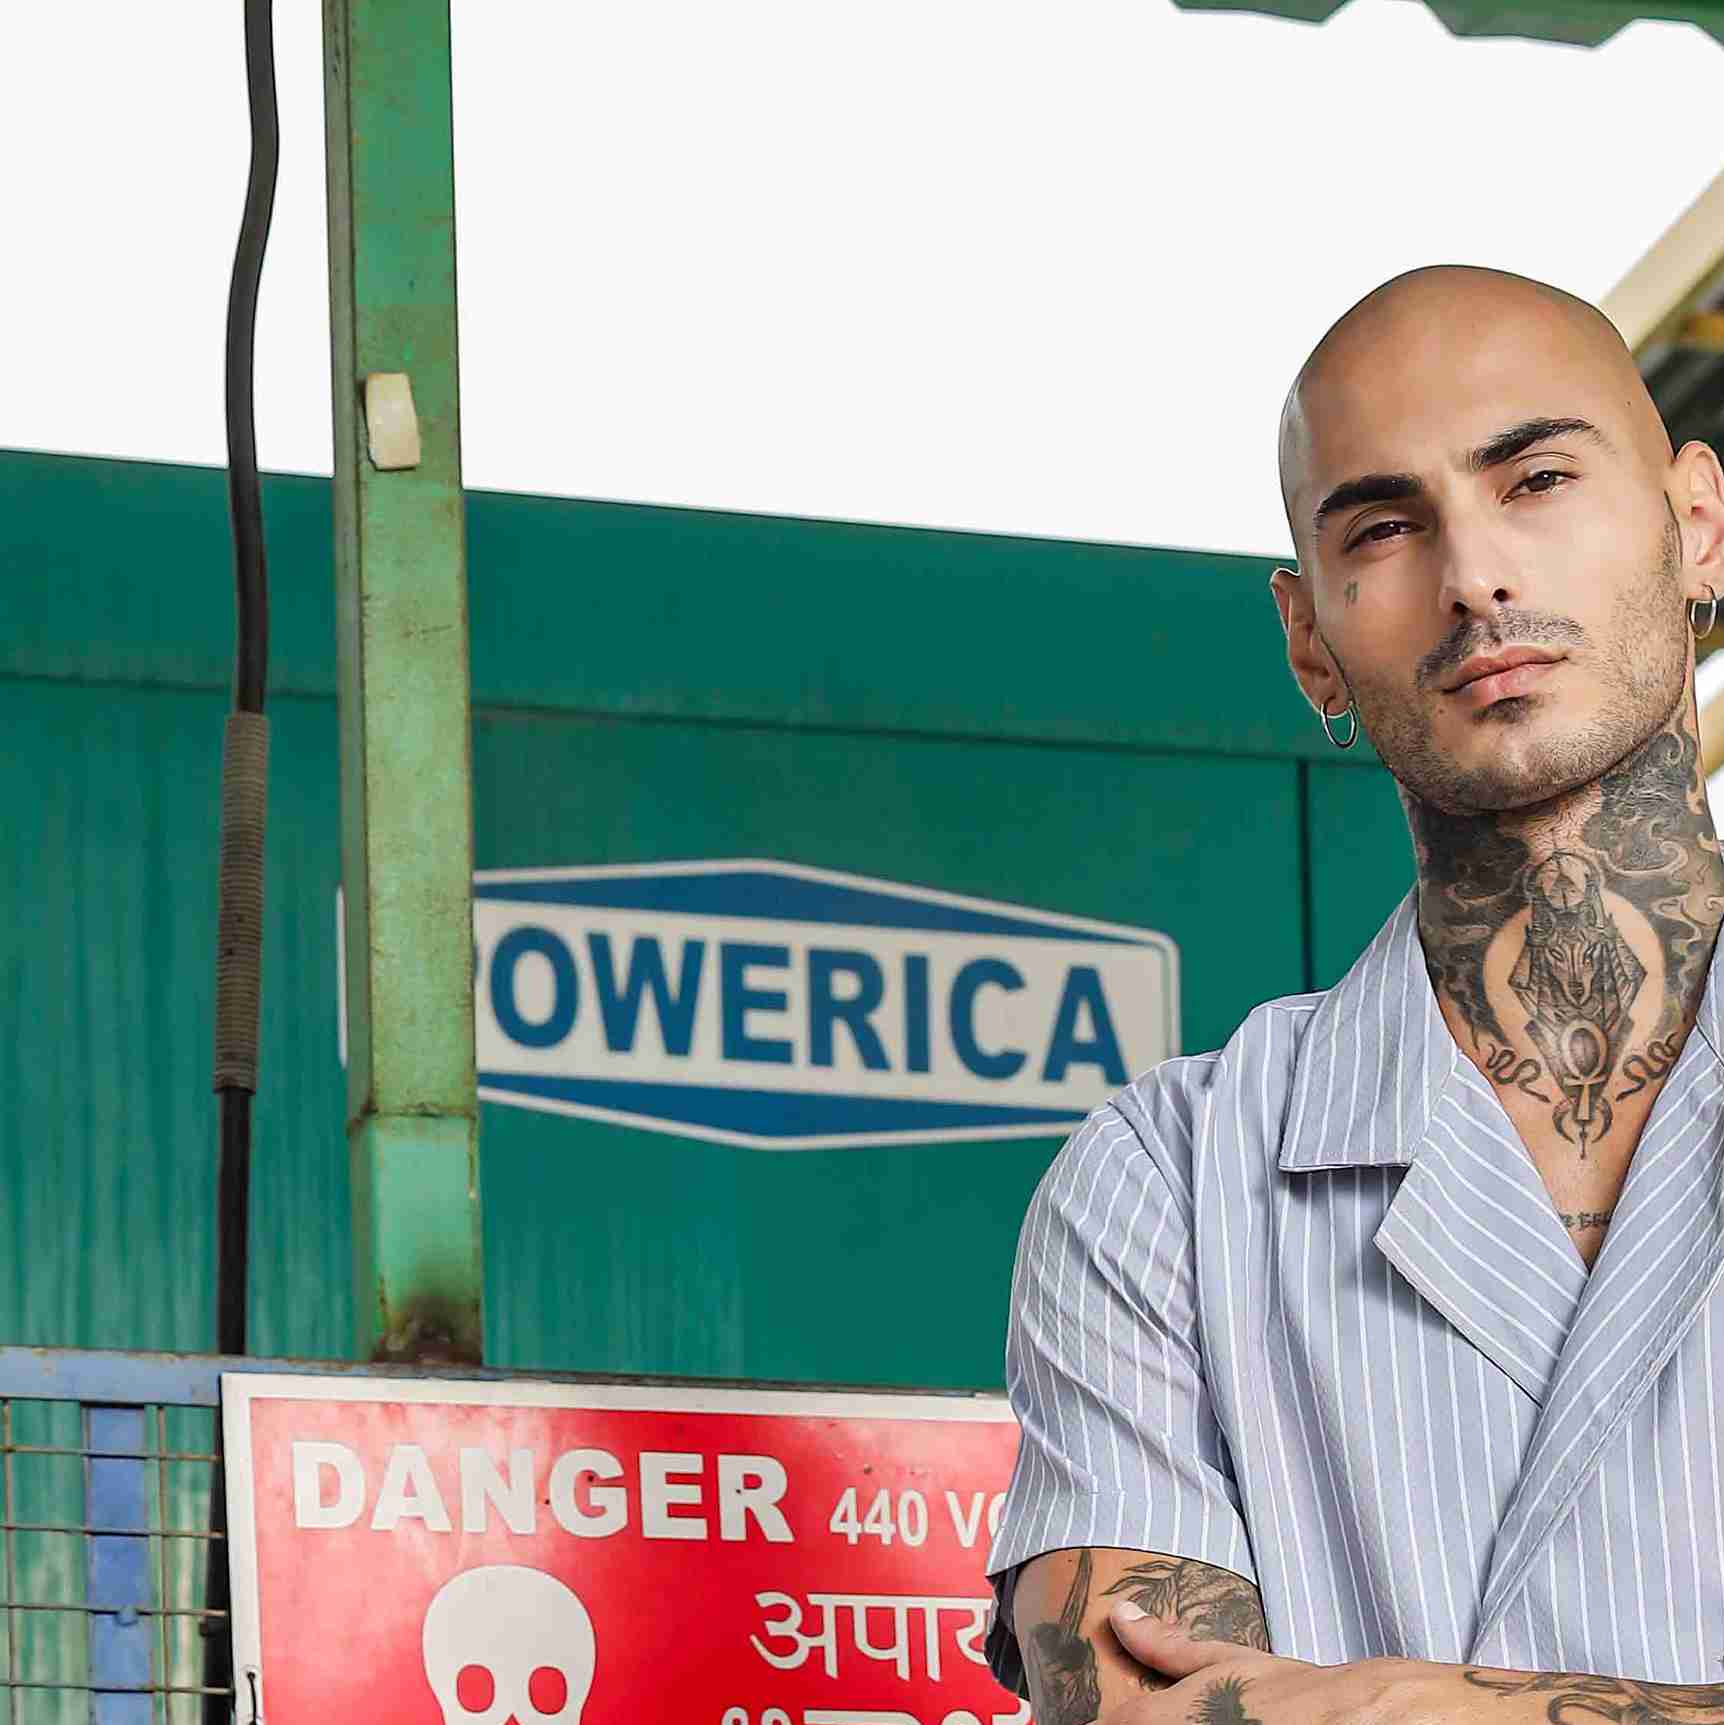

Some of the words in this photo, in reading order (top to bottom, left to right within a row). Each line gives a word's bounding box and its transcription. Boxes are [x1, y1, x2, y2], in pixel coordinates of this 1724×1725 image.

[476, 924, 1127, 1086] OWERICA
[292, 1441, 796, 1543] DANGER
[829, 1486, 929, 1547] 440
